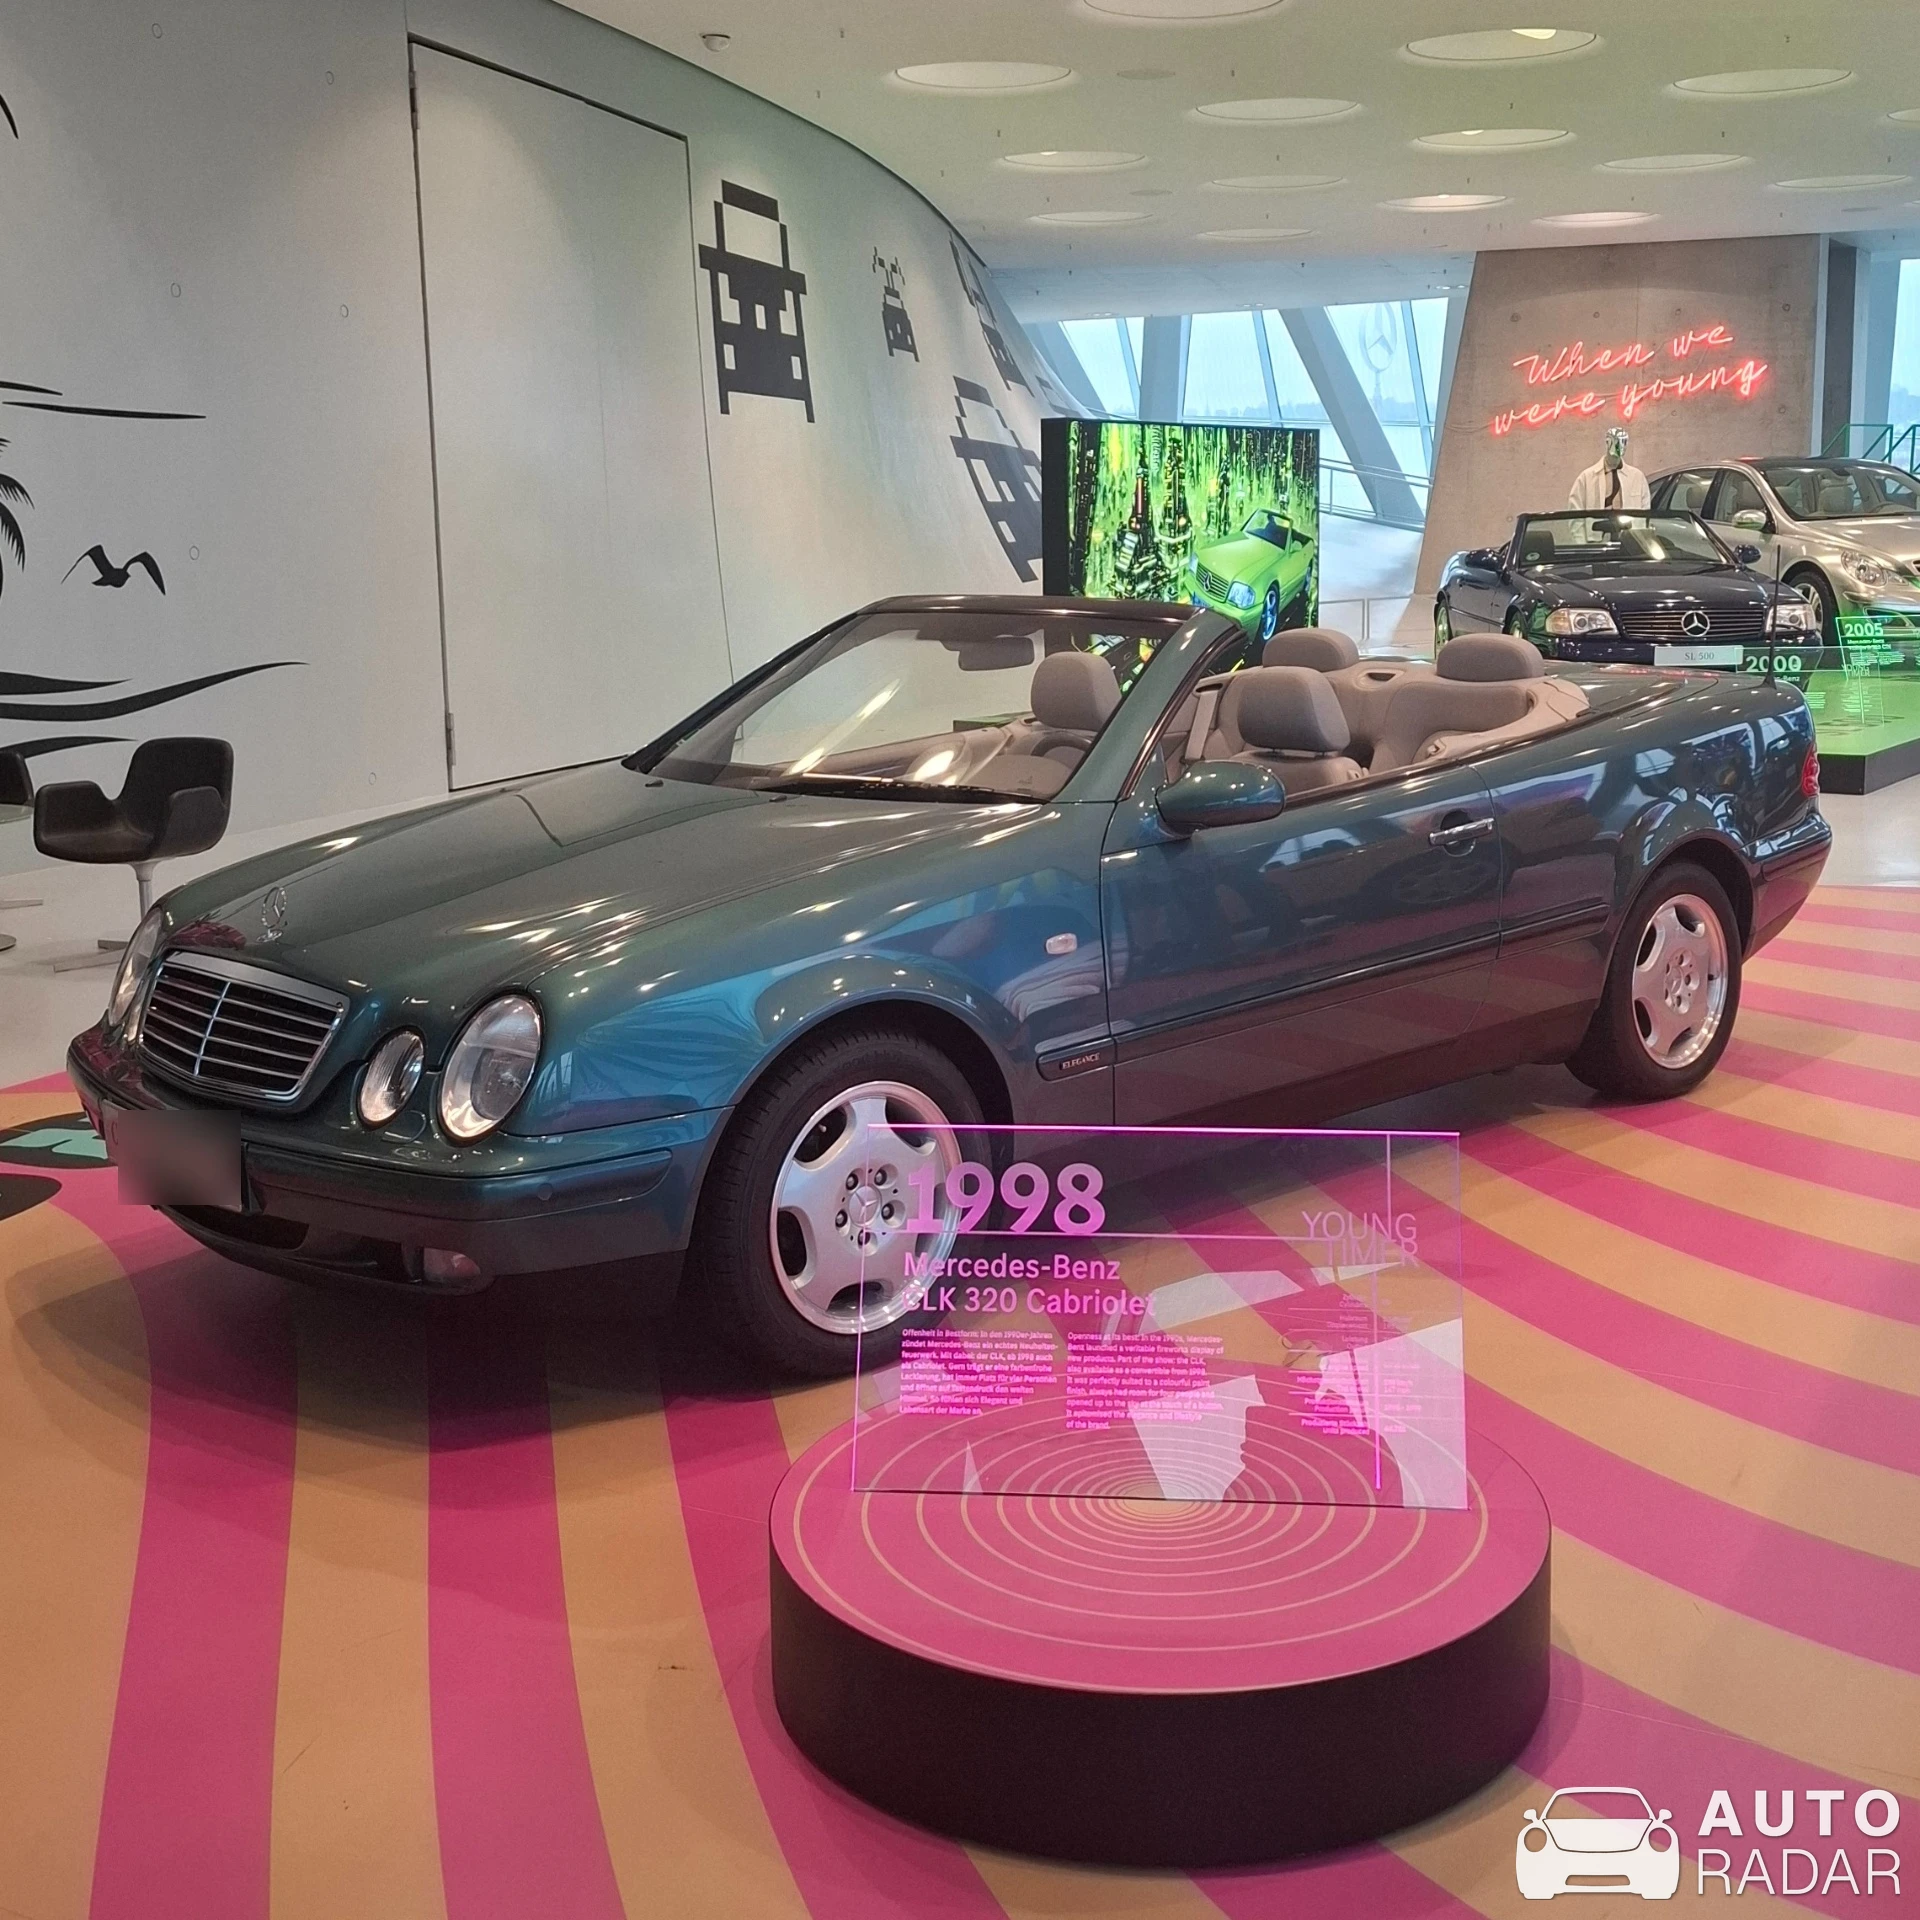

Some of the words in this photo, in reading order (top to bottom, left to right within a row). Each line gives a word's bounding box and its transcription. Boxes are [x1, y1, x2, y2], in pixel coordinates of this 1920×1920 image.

[1513, 341, 1655, 384] When
[1673, 324, 1733, 357] we
[1494, 391, 1606, 435] were
[1621, 360, 1768, 417] young
[1845, 623, 1884, 637] 2005
[1684, 652, 1696, 661] SL
[1698, 652, 1715, 660] 500
[1746, 655, 1801, 672] 2000
[1062, 1052, 1100, 1070] ELEGANCE
[906, 1161, 1106, 1234] 1998
[1301, 1211, 1417, 1241] YOUNG
[1324, 1238, 1420, 1267] TIMER
[904, 1252, 1120, 1280] Mercedes-Benz
[902, 1286, 957, 1312] CLK
[964, 1286, 1017, 1313] 320
[1026, 1288, 1155, 1317] Cabriolet
[902, 1329, 935, 1337] Offenheit
[937, 1329, 943, 1337] in
[1068, 1332, 1101, 1341] Openness
[927, 1340, 980, 1348] Mercedes-Benz
[977, 1352, 988, 1360] der
[990, 1352, 1006, 1361] CLK,
